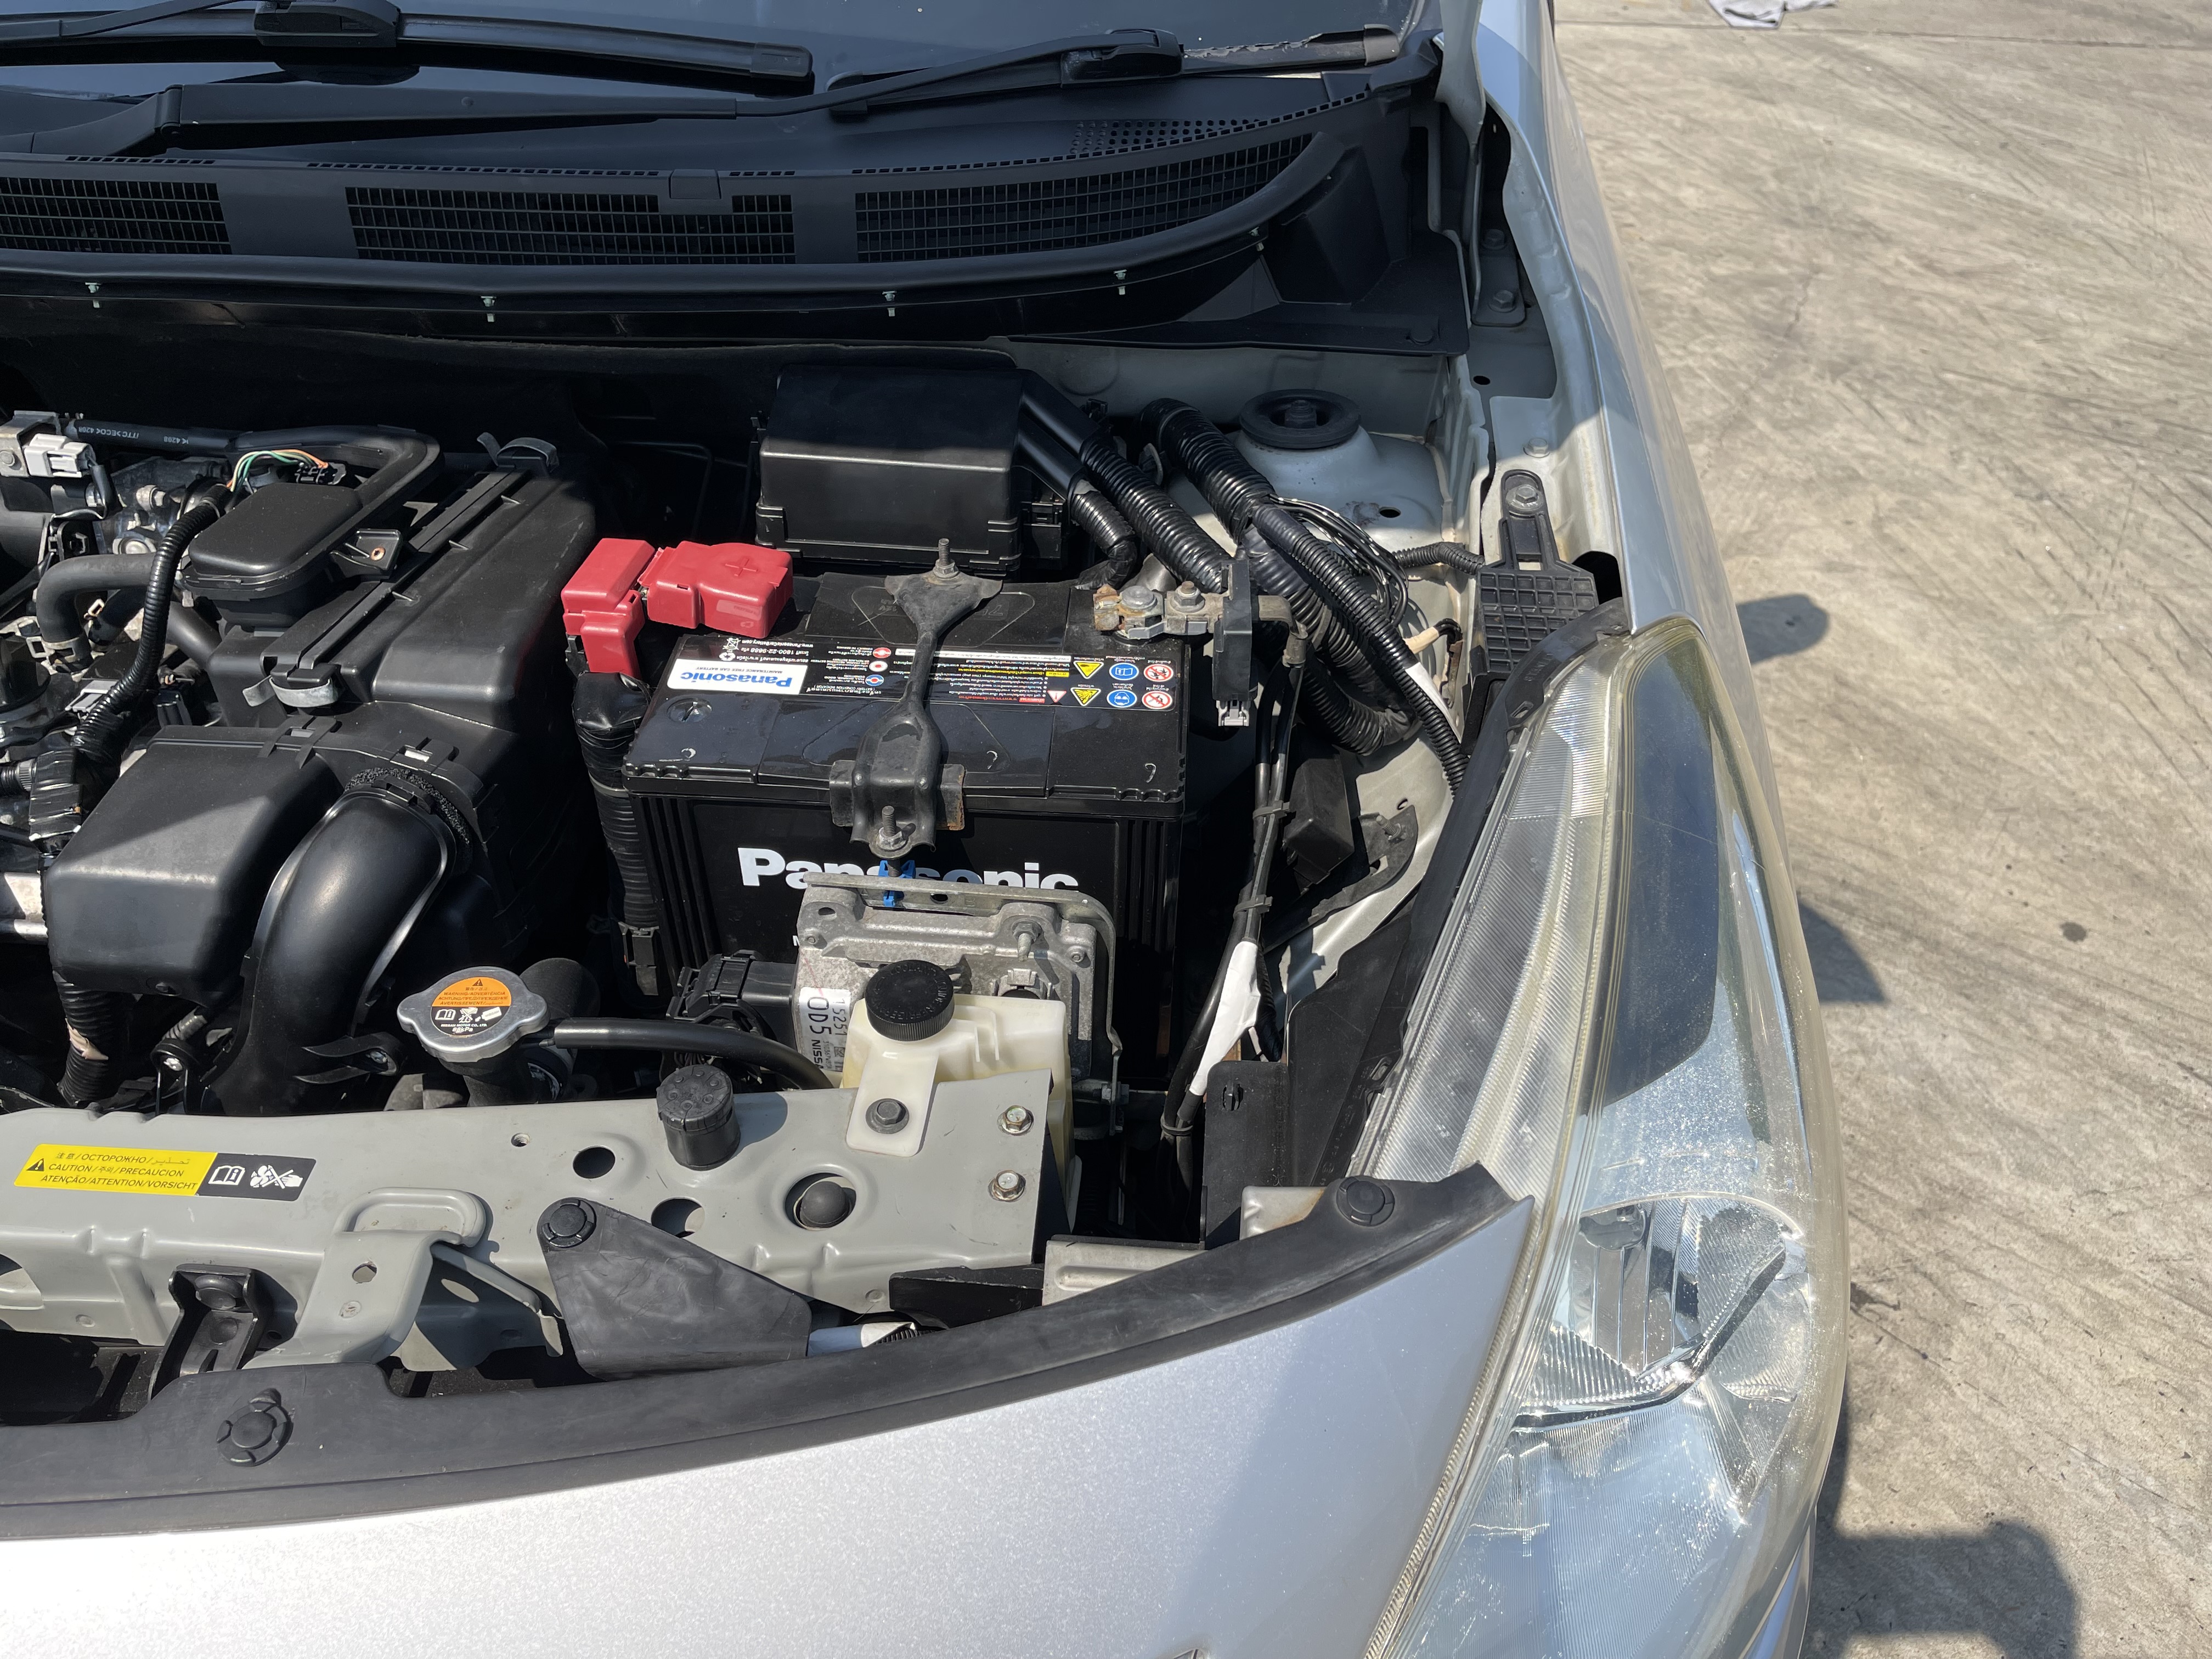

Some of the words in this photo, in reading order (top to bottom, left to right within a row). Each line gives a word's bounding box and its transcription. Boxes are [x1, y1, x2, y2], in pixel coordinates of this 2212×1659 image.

[680, 672, 793, 687] Panasonic
[738, 848, 1079, 892] Panic
[811, 1039, 824, 1069] NISSA
